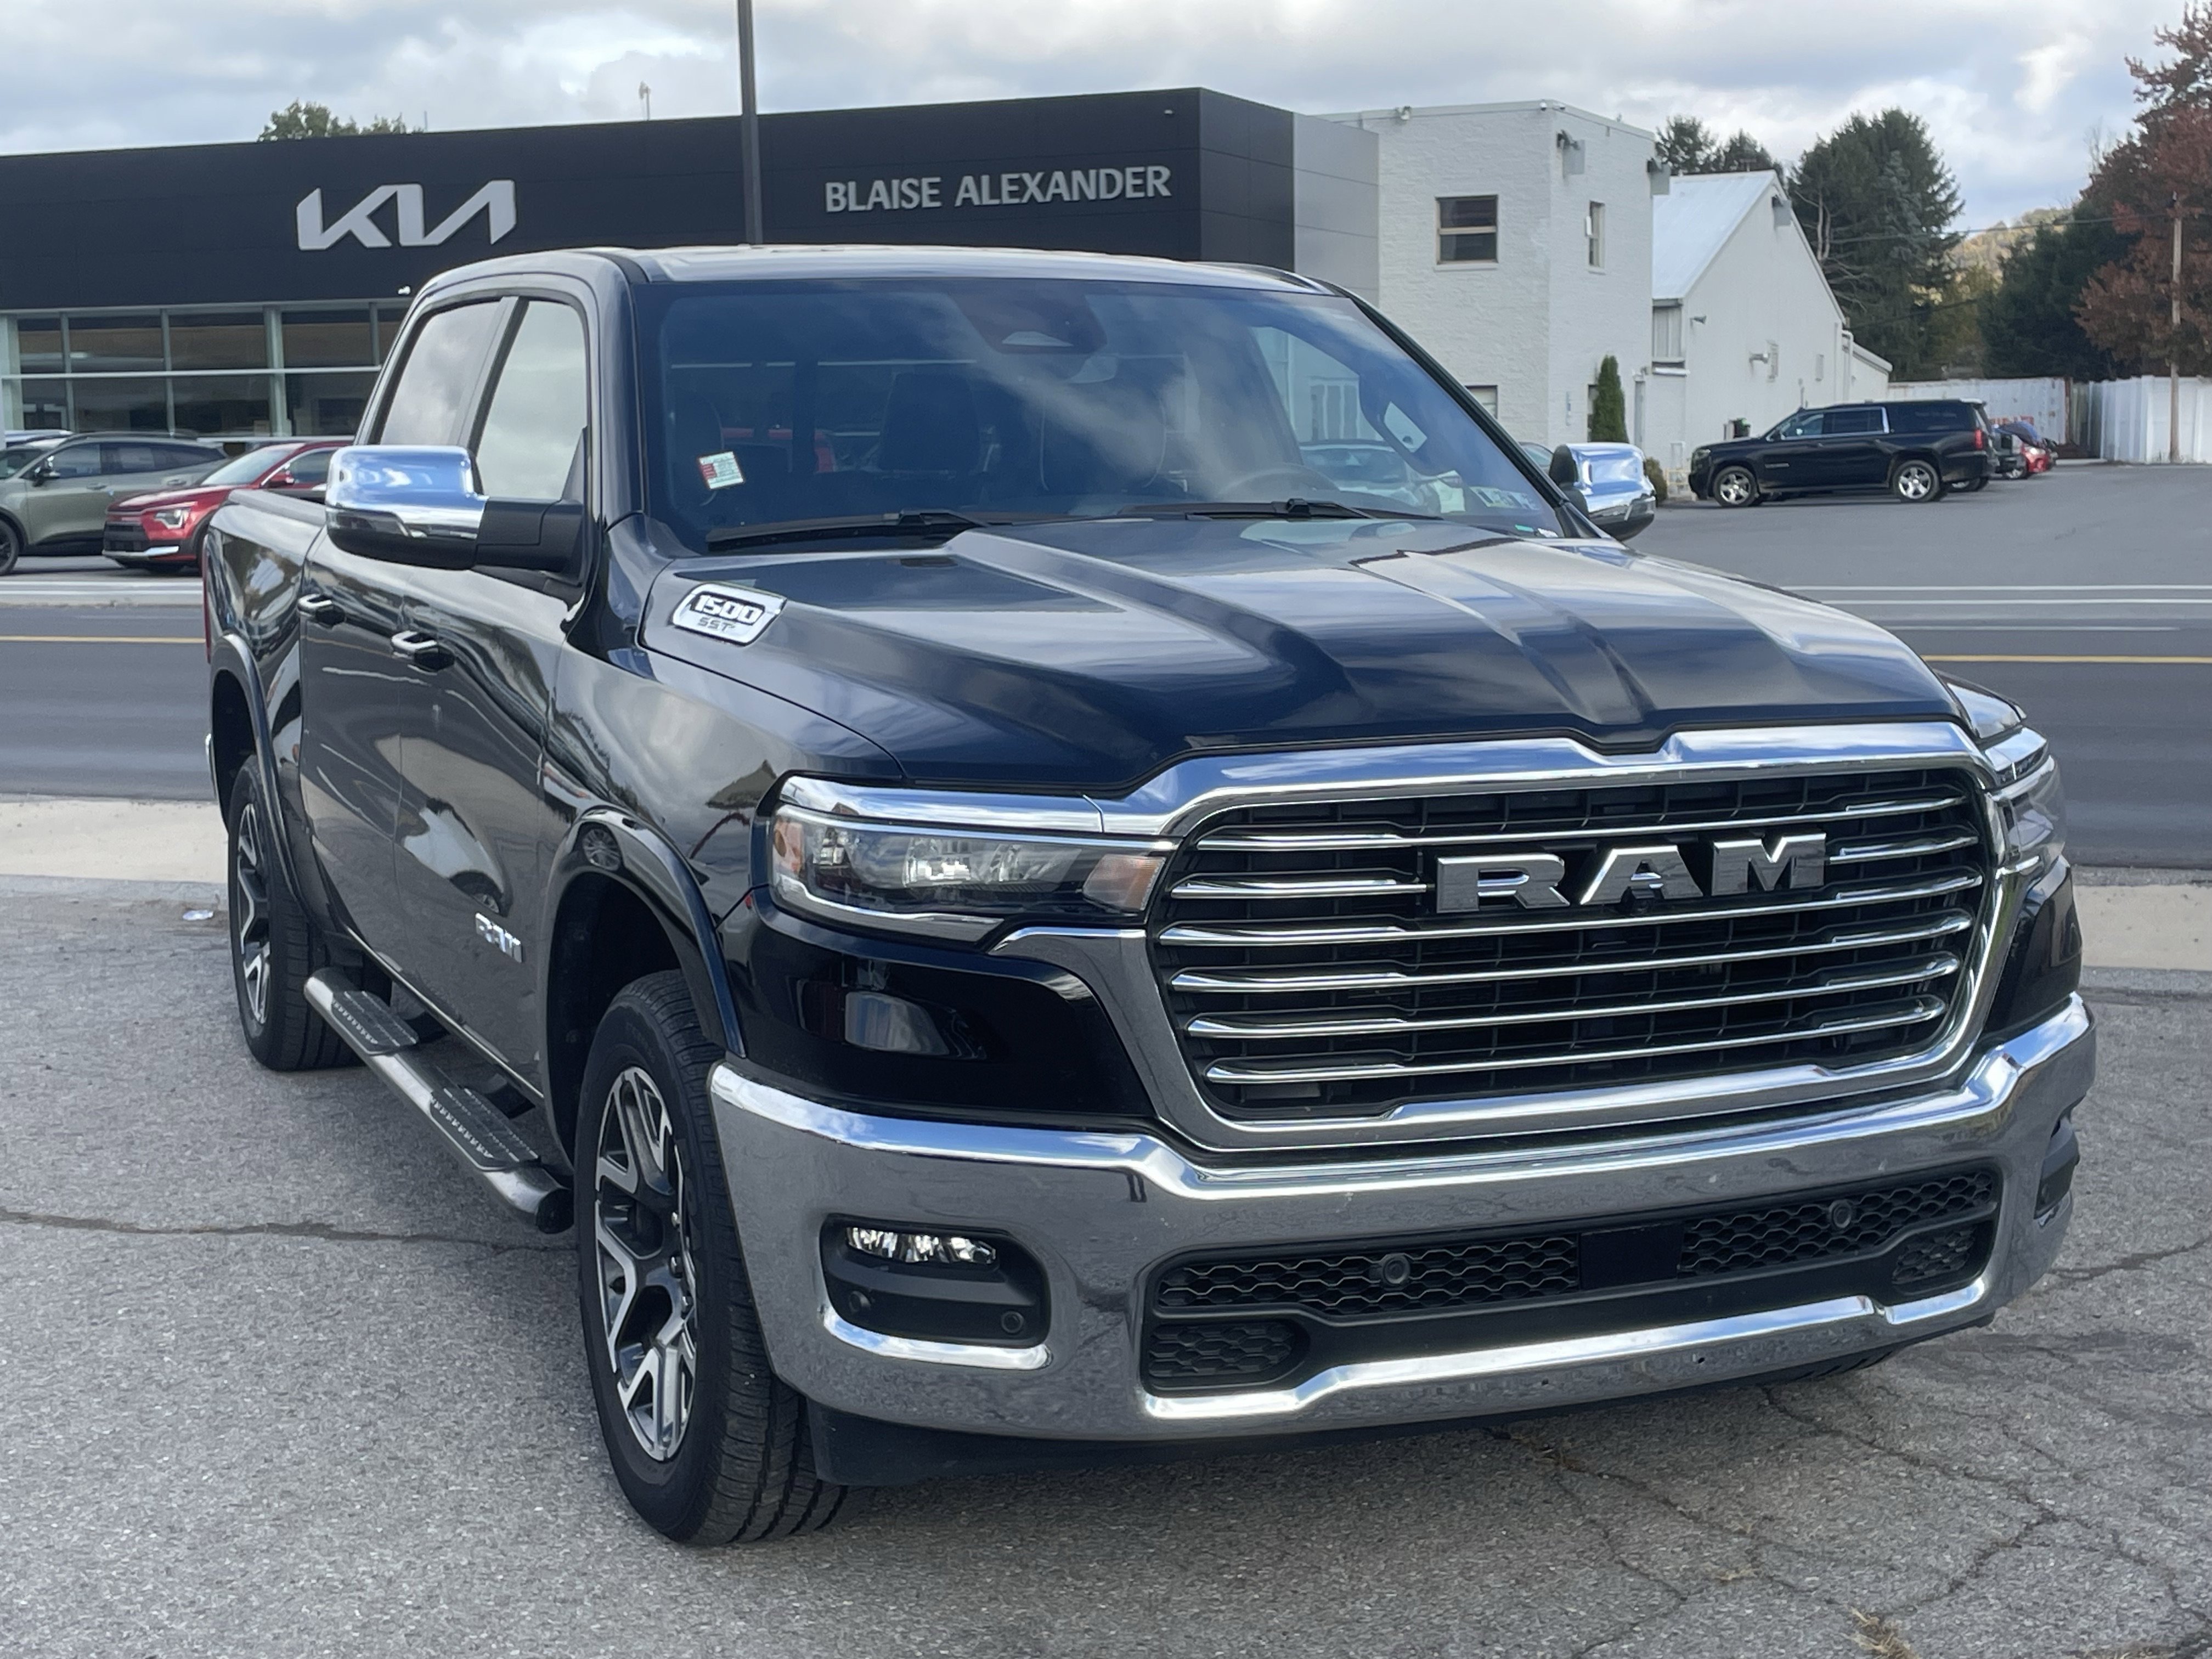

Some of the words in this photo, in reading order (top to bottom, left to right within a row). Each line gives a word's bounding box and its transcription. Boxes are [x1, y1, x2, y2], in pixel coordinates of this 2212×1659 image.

[296, 179, 517, 250] KIA
[826, 177, 941, 212] BLAISE
[954, 166, 1172, 206] ALEXANDER
[695, 595, 763, 624] 1500
[1436, 833, 1826, 913] RAM
